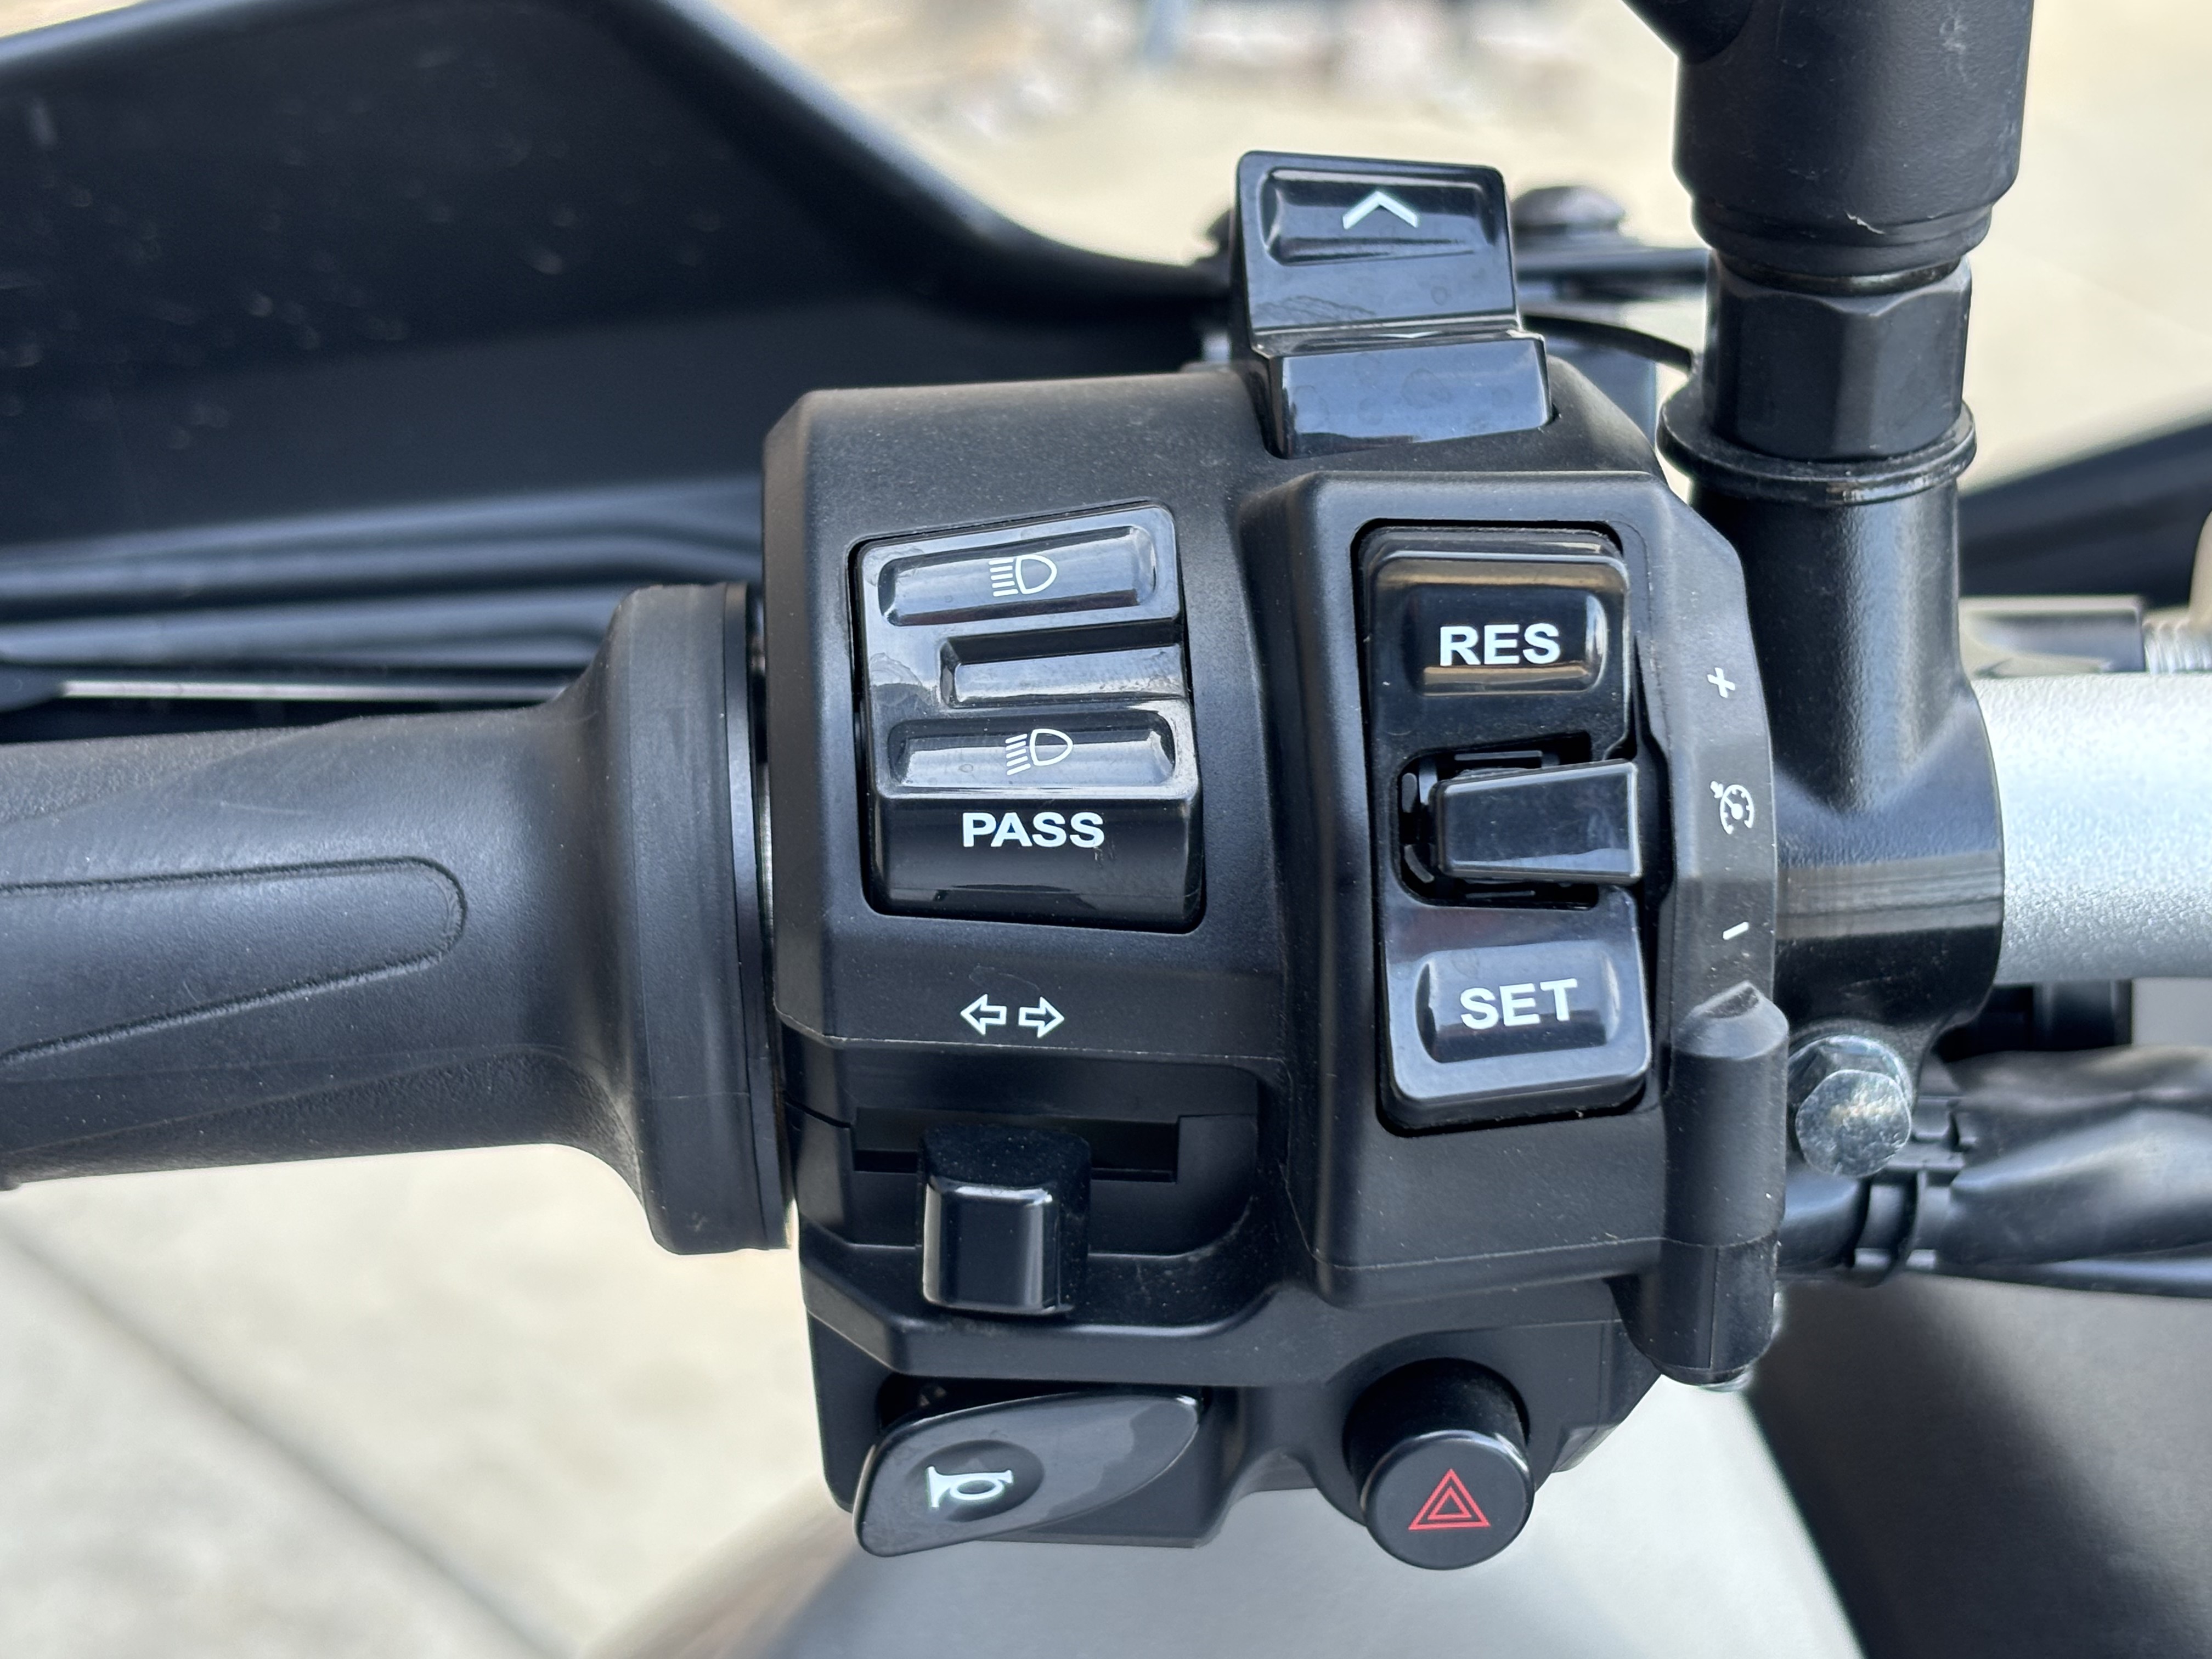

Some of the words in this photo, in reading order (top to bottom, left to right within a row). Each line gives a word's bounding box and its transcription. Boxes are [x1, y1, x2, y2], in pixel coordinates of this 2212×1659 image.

[1440, 623, 1560, 667] RES
[962, 812, 1105, 848] PASS
[1460, 978, 1578, 1030] SET
